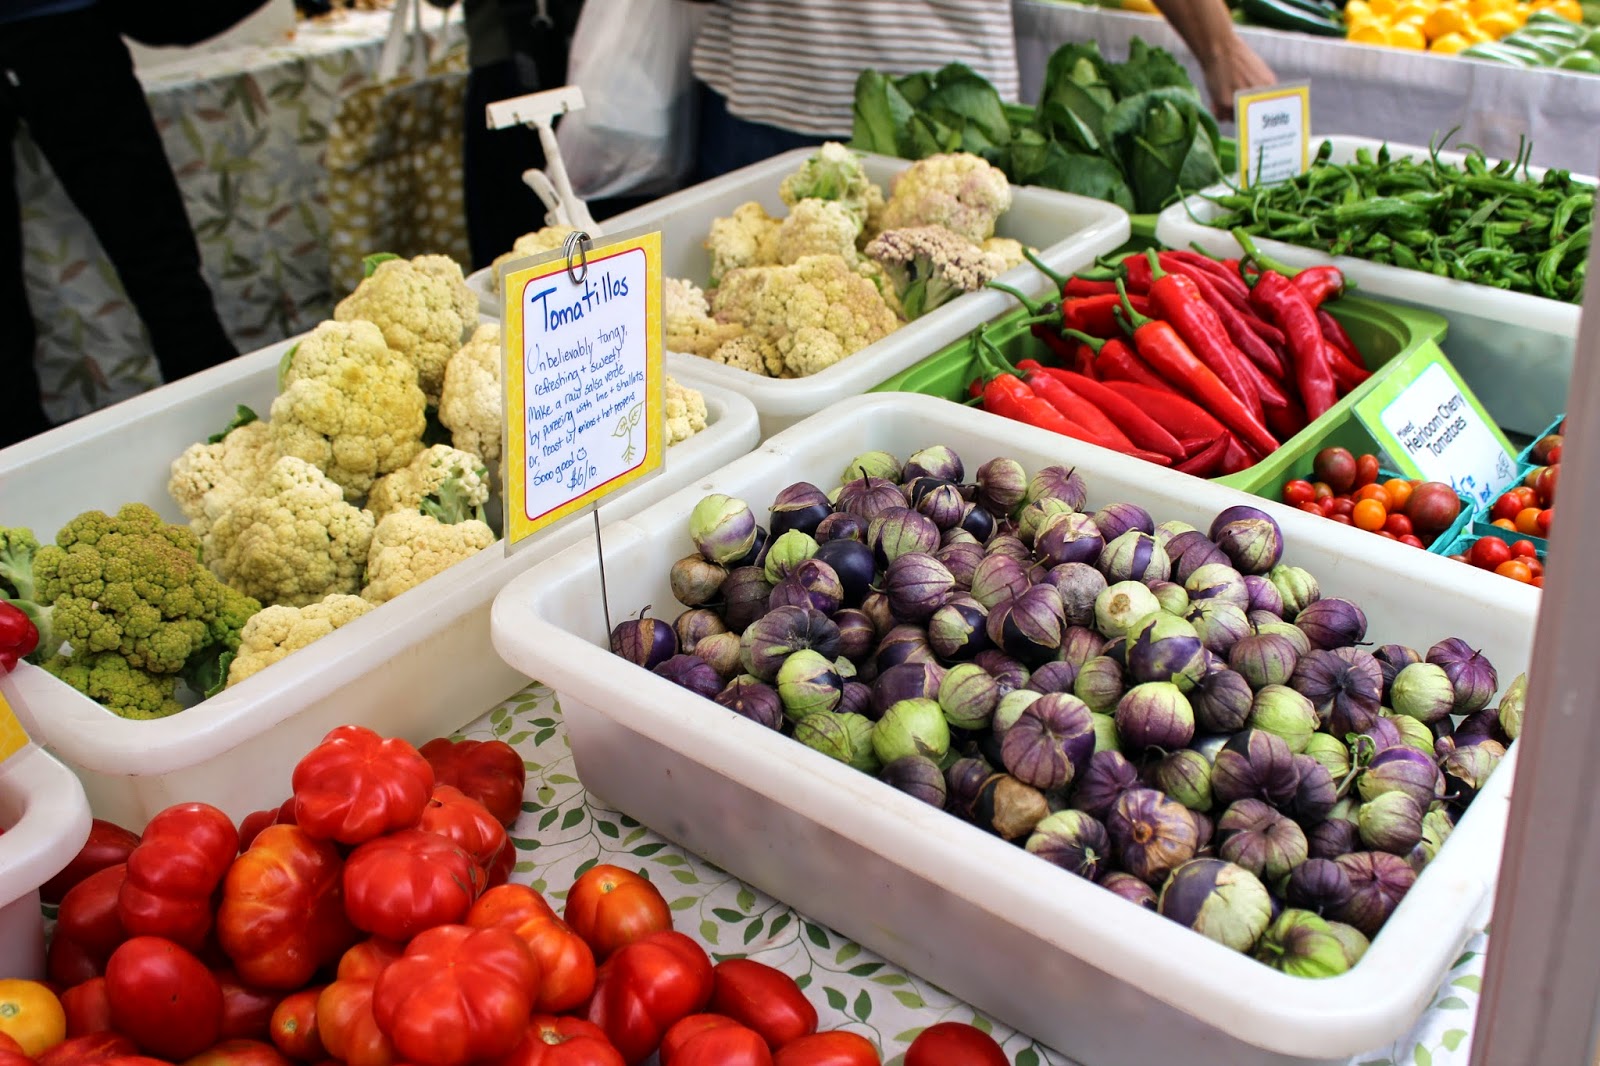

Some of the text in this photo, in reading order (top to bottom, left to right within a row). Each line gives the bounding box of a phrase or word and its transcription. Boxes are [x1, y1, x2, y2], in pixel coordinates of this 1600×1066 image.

[531, 272, 629, 332] Tomatillos
[527, 337, 593, 374] Unbelievably
[534, 369, 582, 396] refreshing
[581, 365, 587, 373] +
[528, 362, 626, 424] Make a raw salsa verde
[529, 431, 540, 449] by
[543, 411, 576, 440] pureeing
[576, 400, 593, 414] with
[610, 386, 615, 394] +
[529, 455, 540, 467] Or,
[543, 437, 564, 457] roast
[566, 427, 577, 444] w/
[578, 417, 596, 434] onions
[596, 414, 601, 422] +
[602, 406, 613, 418] hot
[1404, 392, 1466, 455] Heirloom Cherry
[1426, 416, 1467, 457] Tomatoes
[533, 470, 554, 486] Sooo
